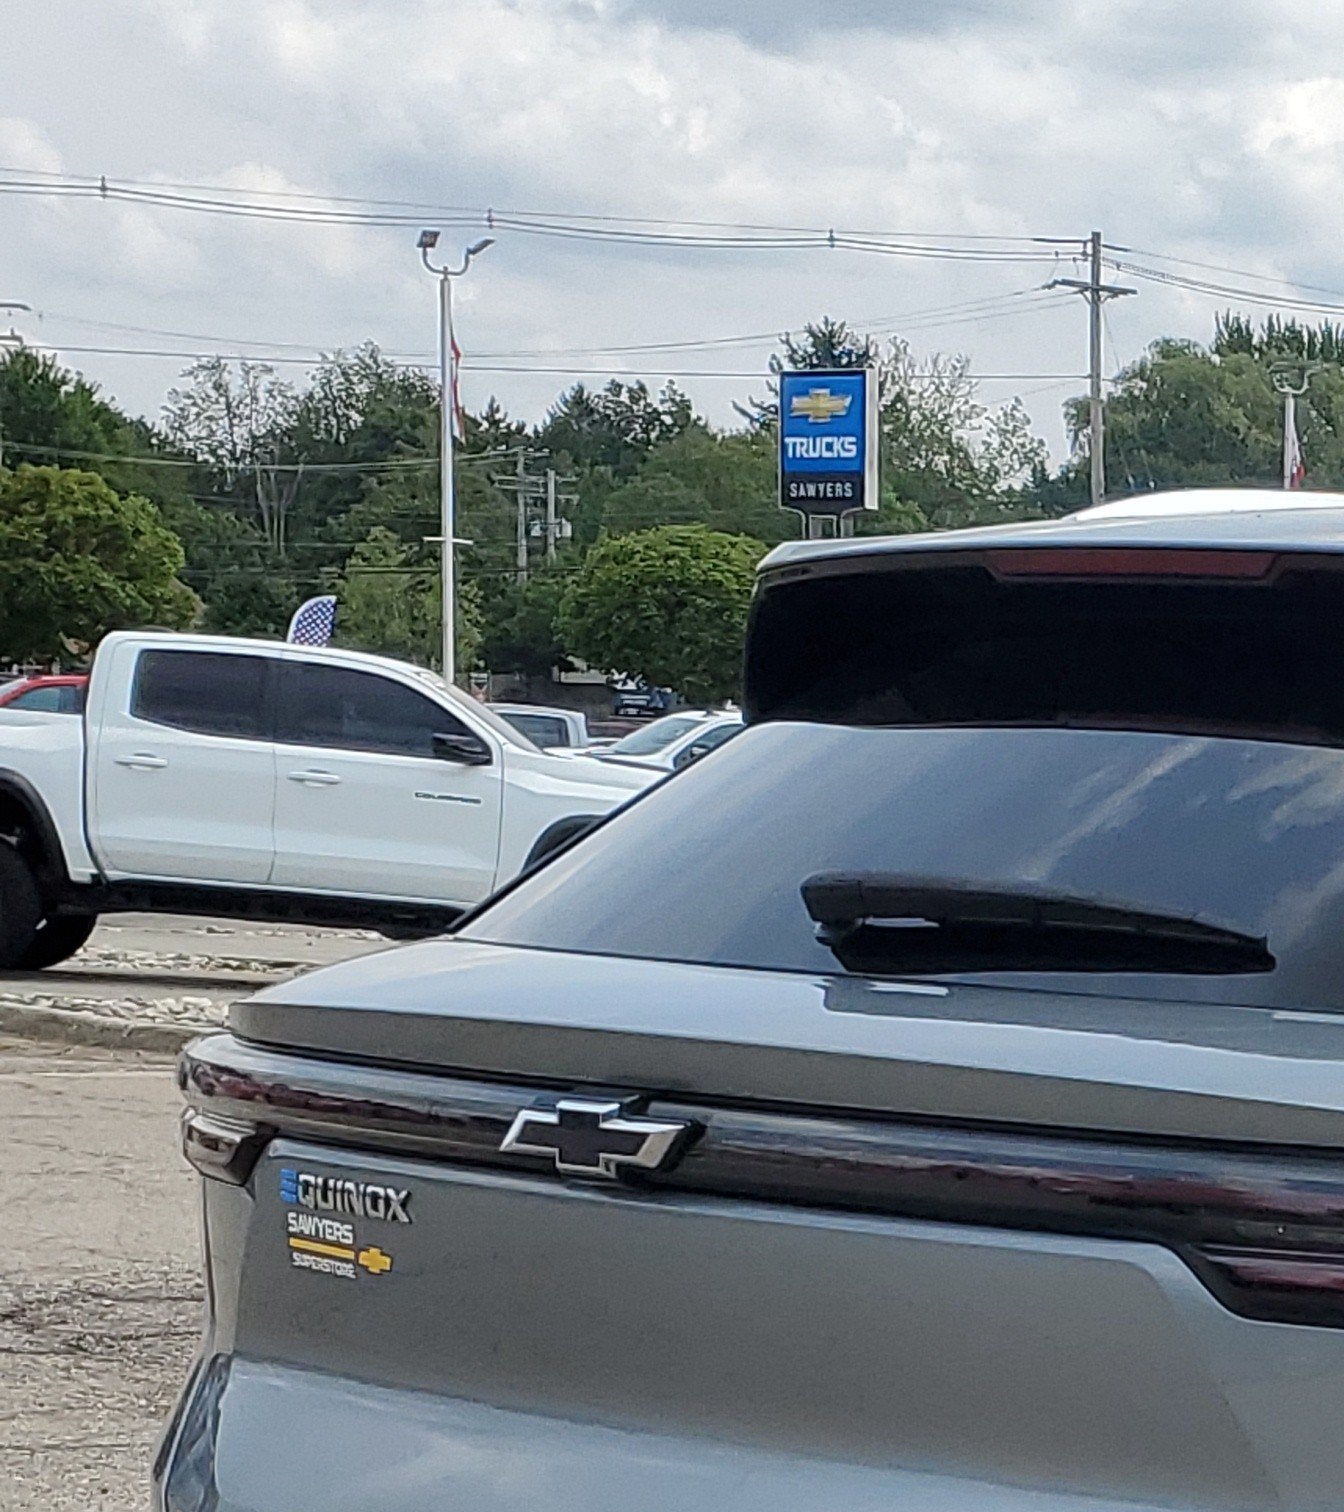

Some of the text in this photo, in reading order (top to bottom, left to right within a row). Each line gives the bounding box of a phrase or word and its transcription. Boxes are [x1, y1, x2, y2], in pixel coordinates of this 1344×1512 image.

[784, 436, 857, 458] TRUCKS
[789, 482, 853, 498] SAWYERS
[280, 1168, 411, 1223] EQUINOX
[287, 1211, 354, 1244] SAWYERS
